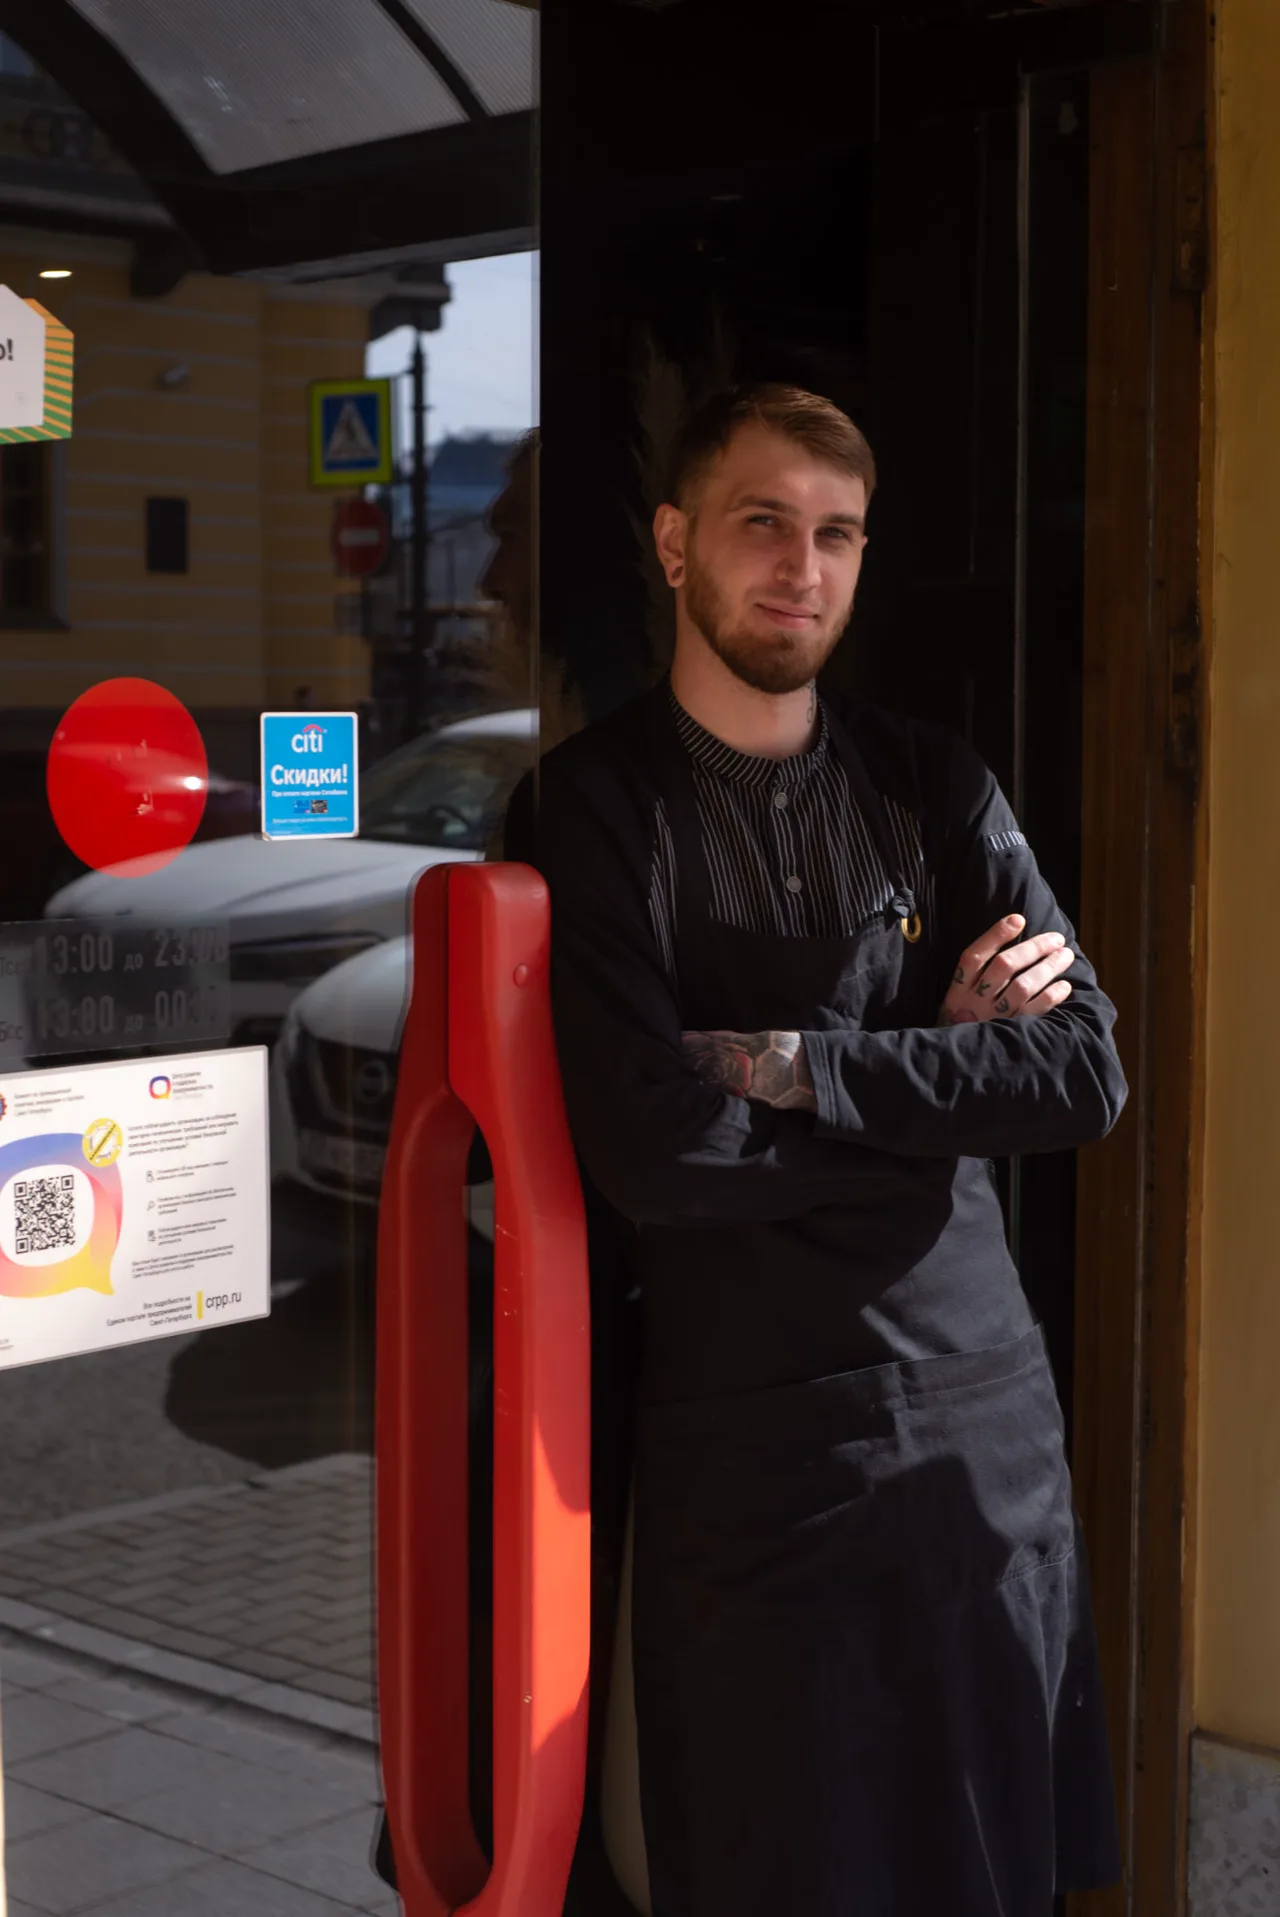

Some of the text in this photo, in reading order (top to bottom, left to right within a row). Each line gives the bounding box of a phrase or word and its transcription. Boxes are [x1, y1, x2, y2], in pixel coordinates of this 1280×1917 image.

[291, 728, 323, 753] citi
[270, 764, 348, 787] Скидки!
[124, 953, 144, 972] до
[125, 1014, 144, 1034] до
[205, 1292, 242, 1310] crpp.ru
